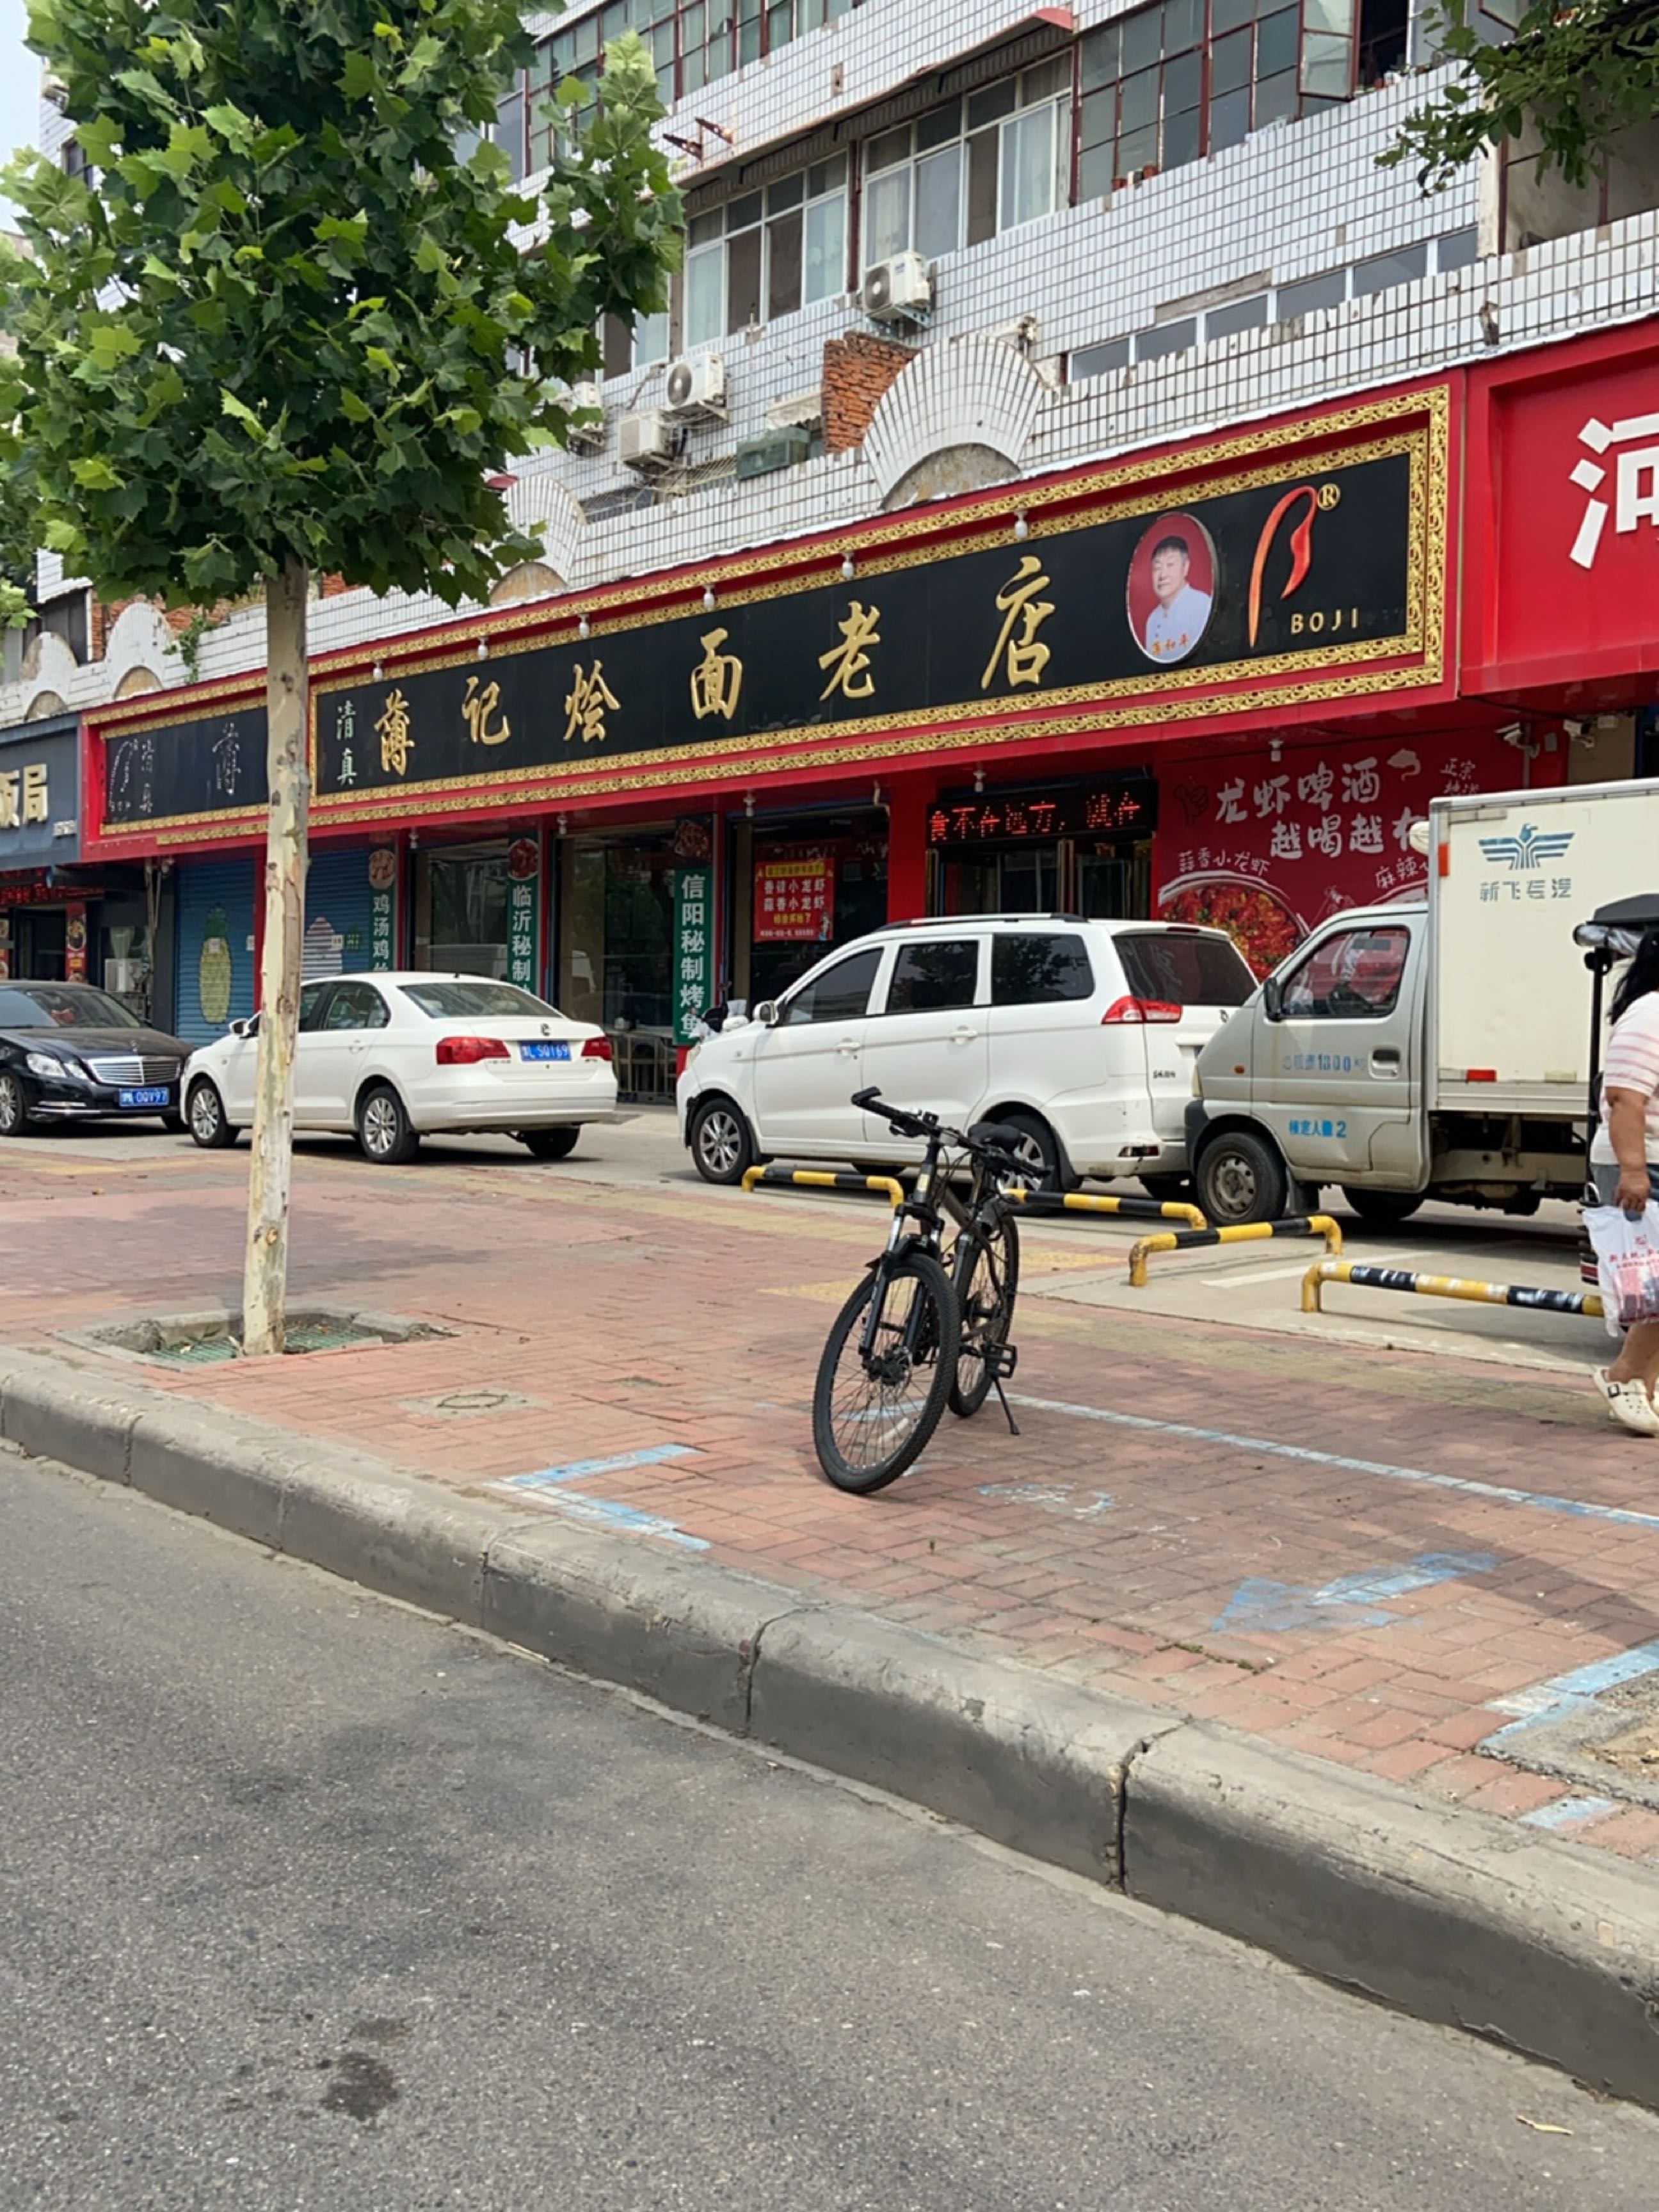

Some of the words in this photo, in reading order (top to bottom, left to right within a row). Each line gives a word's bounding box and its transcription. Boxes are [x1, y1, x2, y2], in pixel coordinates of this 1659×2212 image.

[1291, 608, 1358, 635] BOJI
[337, 700, 357, 786] 清真
[1216, 757, 1380, 824] 龙虾啤酒
[1178, 847, 1271, 876] 蒜香小龙虾
[1480, 878, 1572, 902] 新飞专汽
[512, 885, 532, 993] 临沂秘制
[680, 874, 705, 1038] 信阳秘制烤鱼
